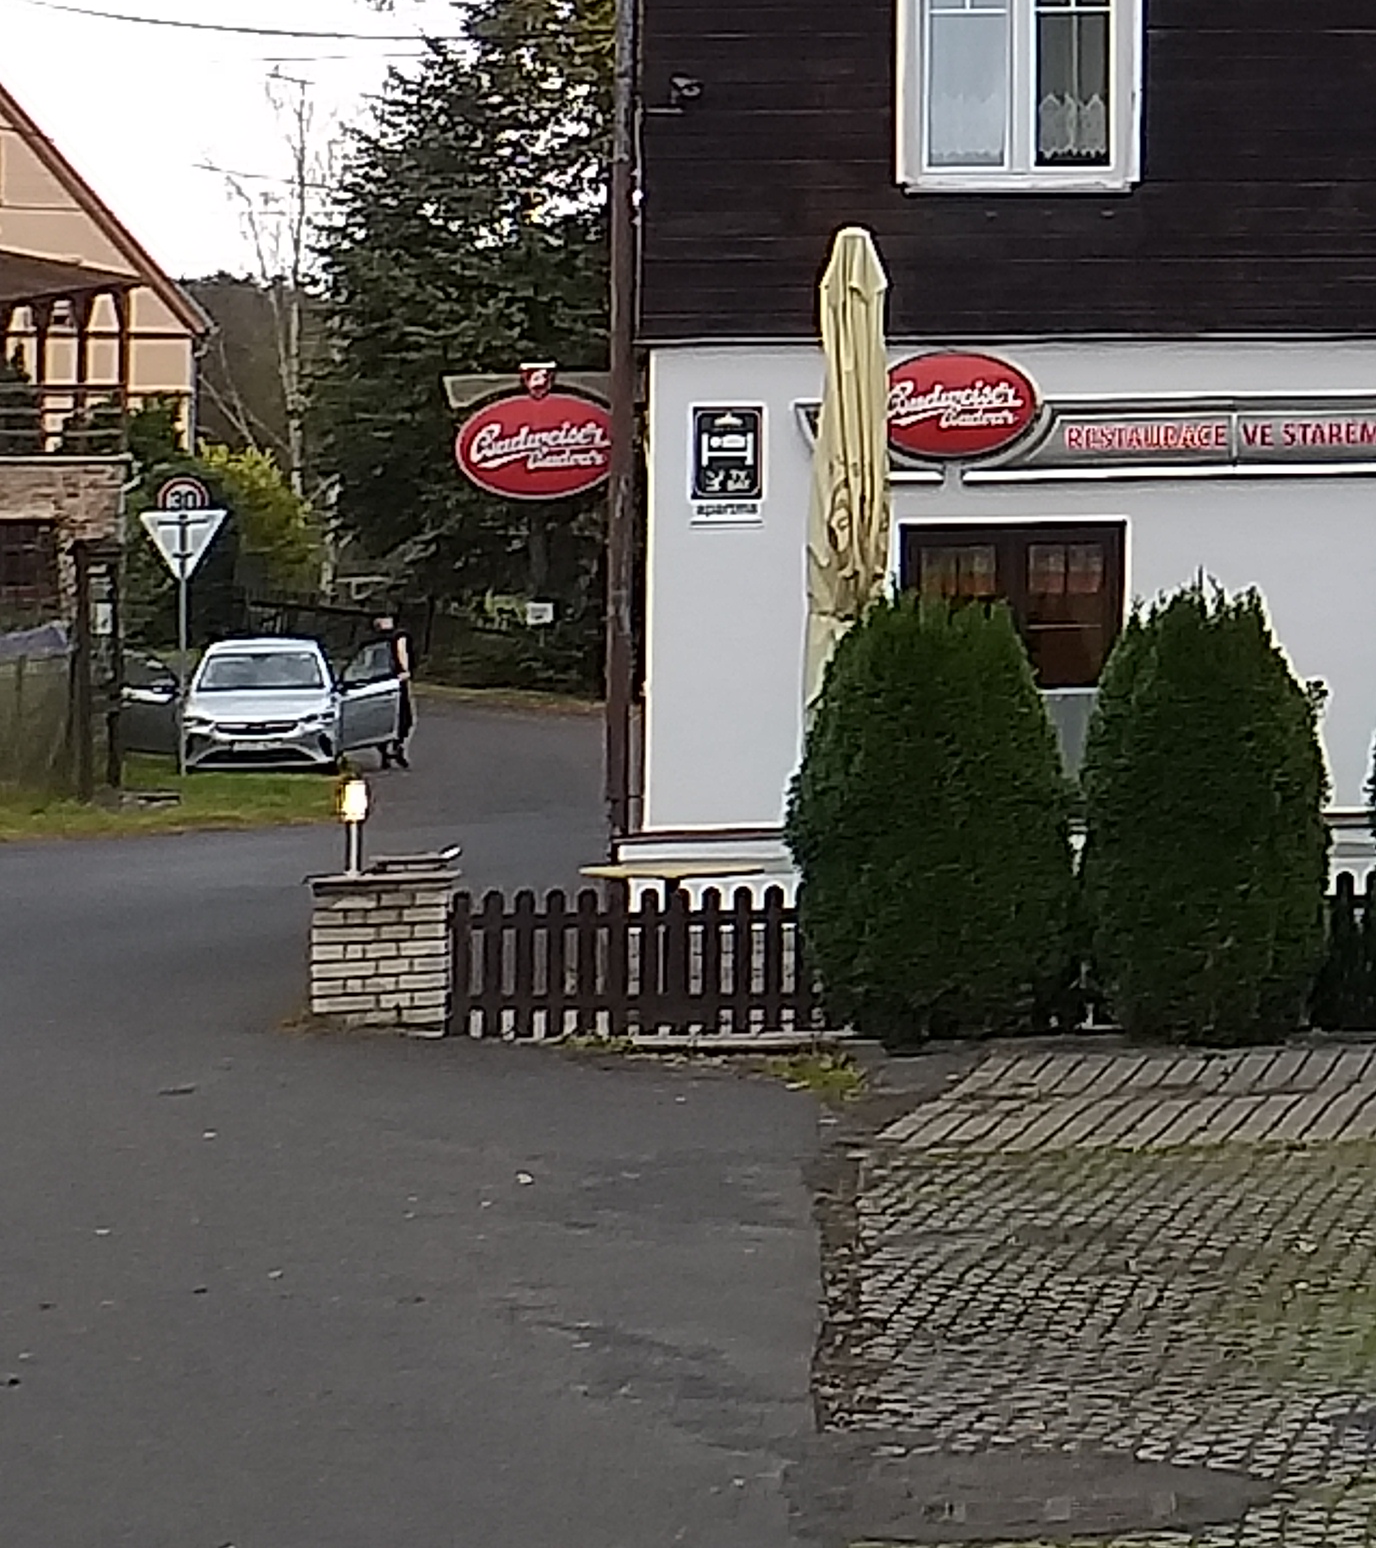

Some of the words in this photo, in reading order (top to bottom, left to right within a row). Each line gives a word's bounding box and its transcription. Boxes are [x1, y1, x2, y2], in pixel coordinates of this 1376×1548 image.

[470, 421, 612, 465] Budweiser
[1065, 422, 1229, 450] RESTAURACE
[1241, 423, 1275, 448] VE
[169, 490, 198, 510] 30
